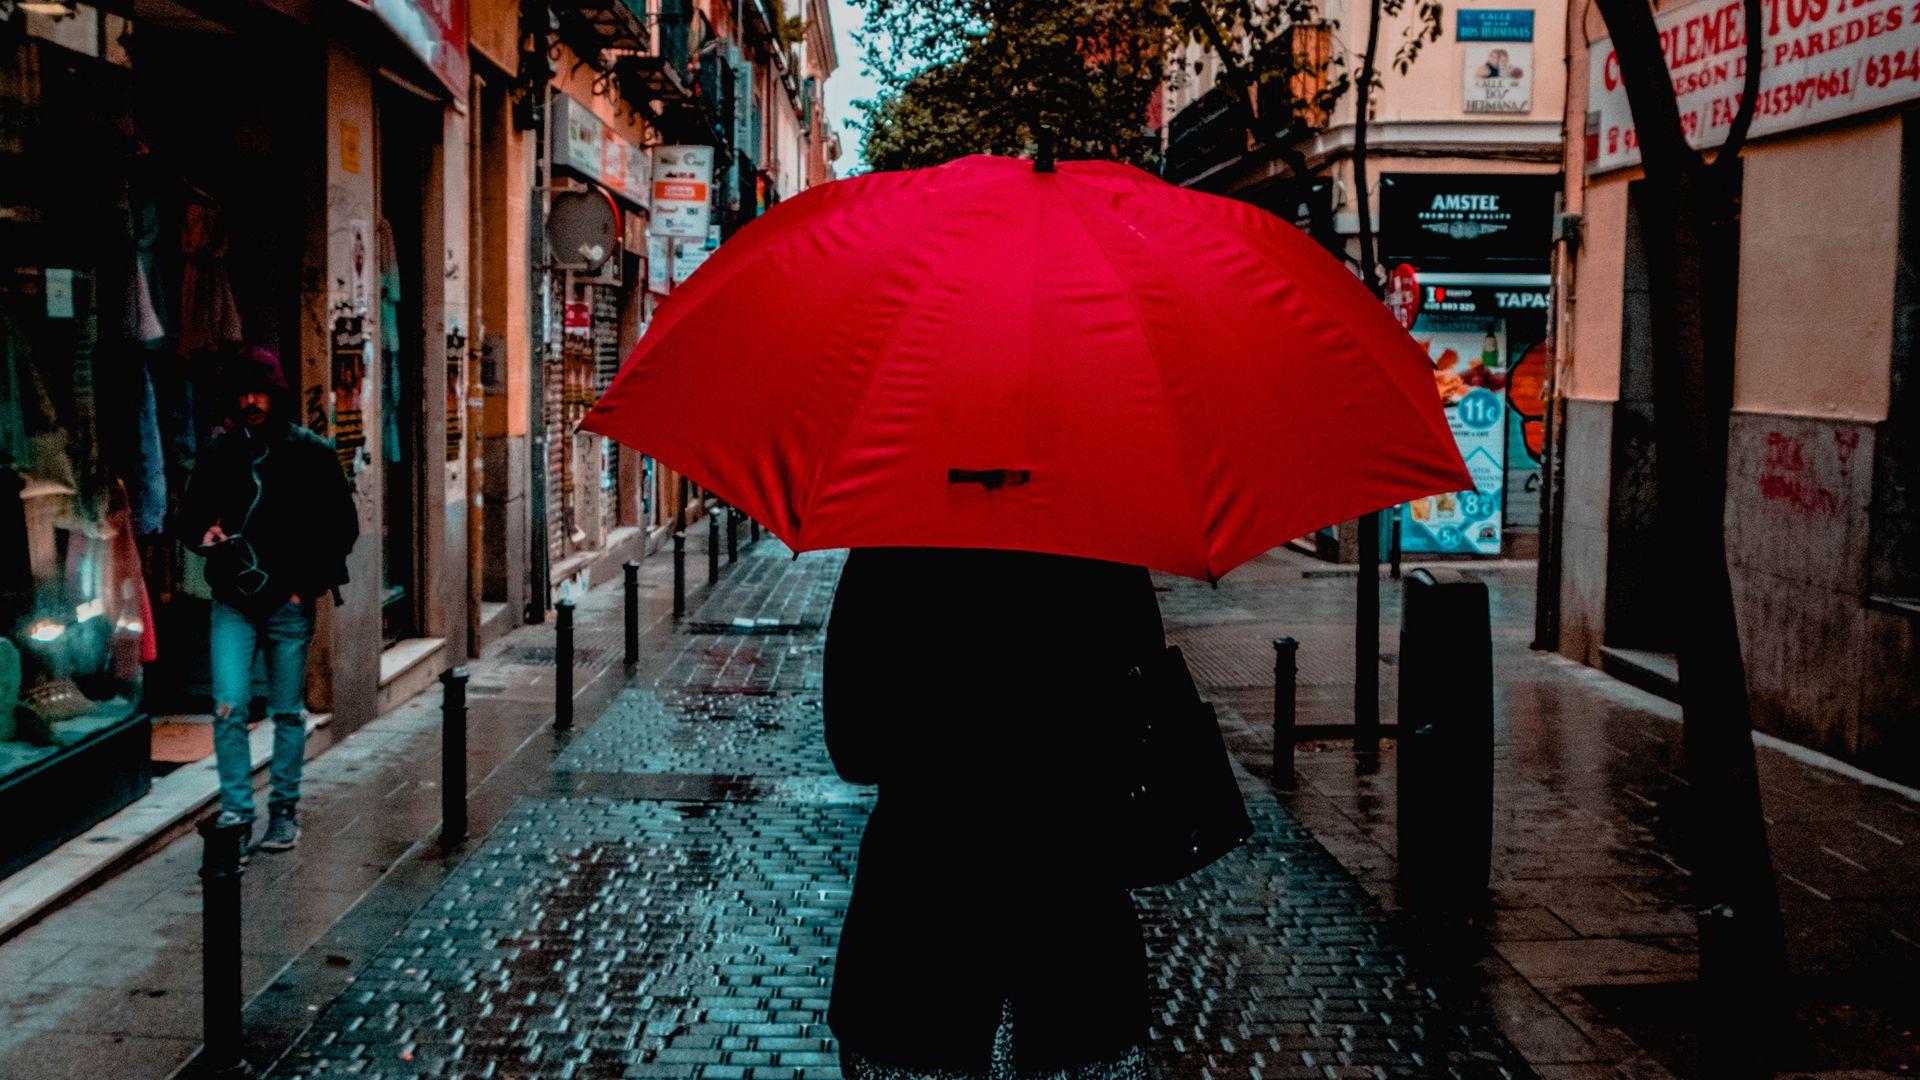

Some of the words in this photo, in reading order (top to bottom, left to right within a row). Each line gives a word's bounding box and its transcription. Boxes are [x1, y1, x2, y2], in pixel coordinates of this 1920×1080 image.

[1481, 12, 1512, 20] CALLE
[1461, 26, 1479, 37] DOS
[1482, 26, 1531, 37] HERMANAS
[1774, 6, 1902, 67] PAREDES
[1475, 79, 1504, 88] CALLE
[1486, 88, 1509, 99] DOS
[1466, 100, 1528, 111] HERMANAS
[1431, 194, 1499, 211] AMSTEL
